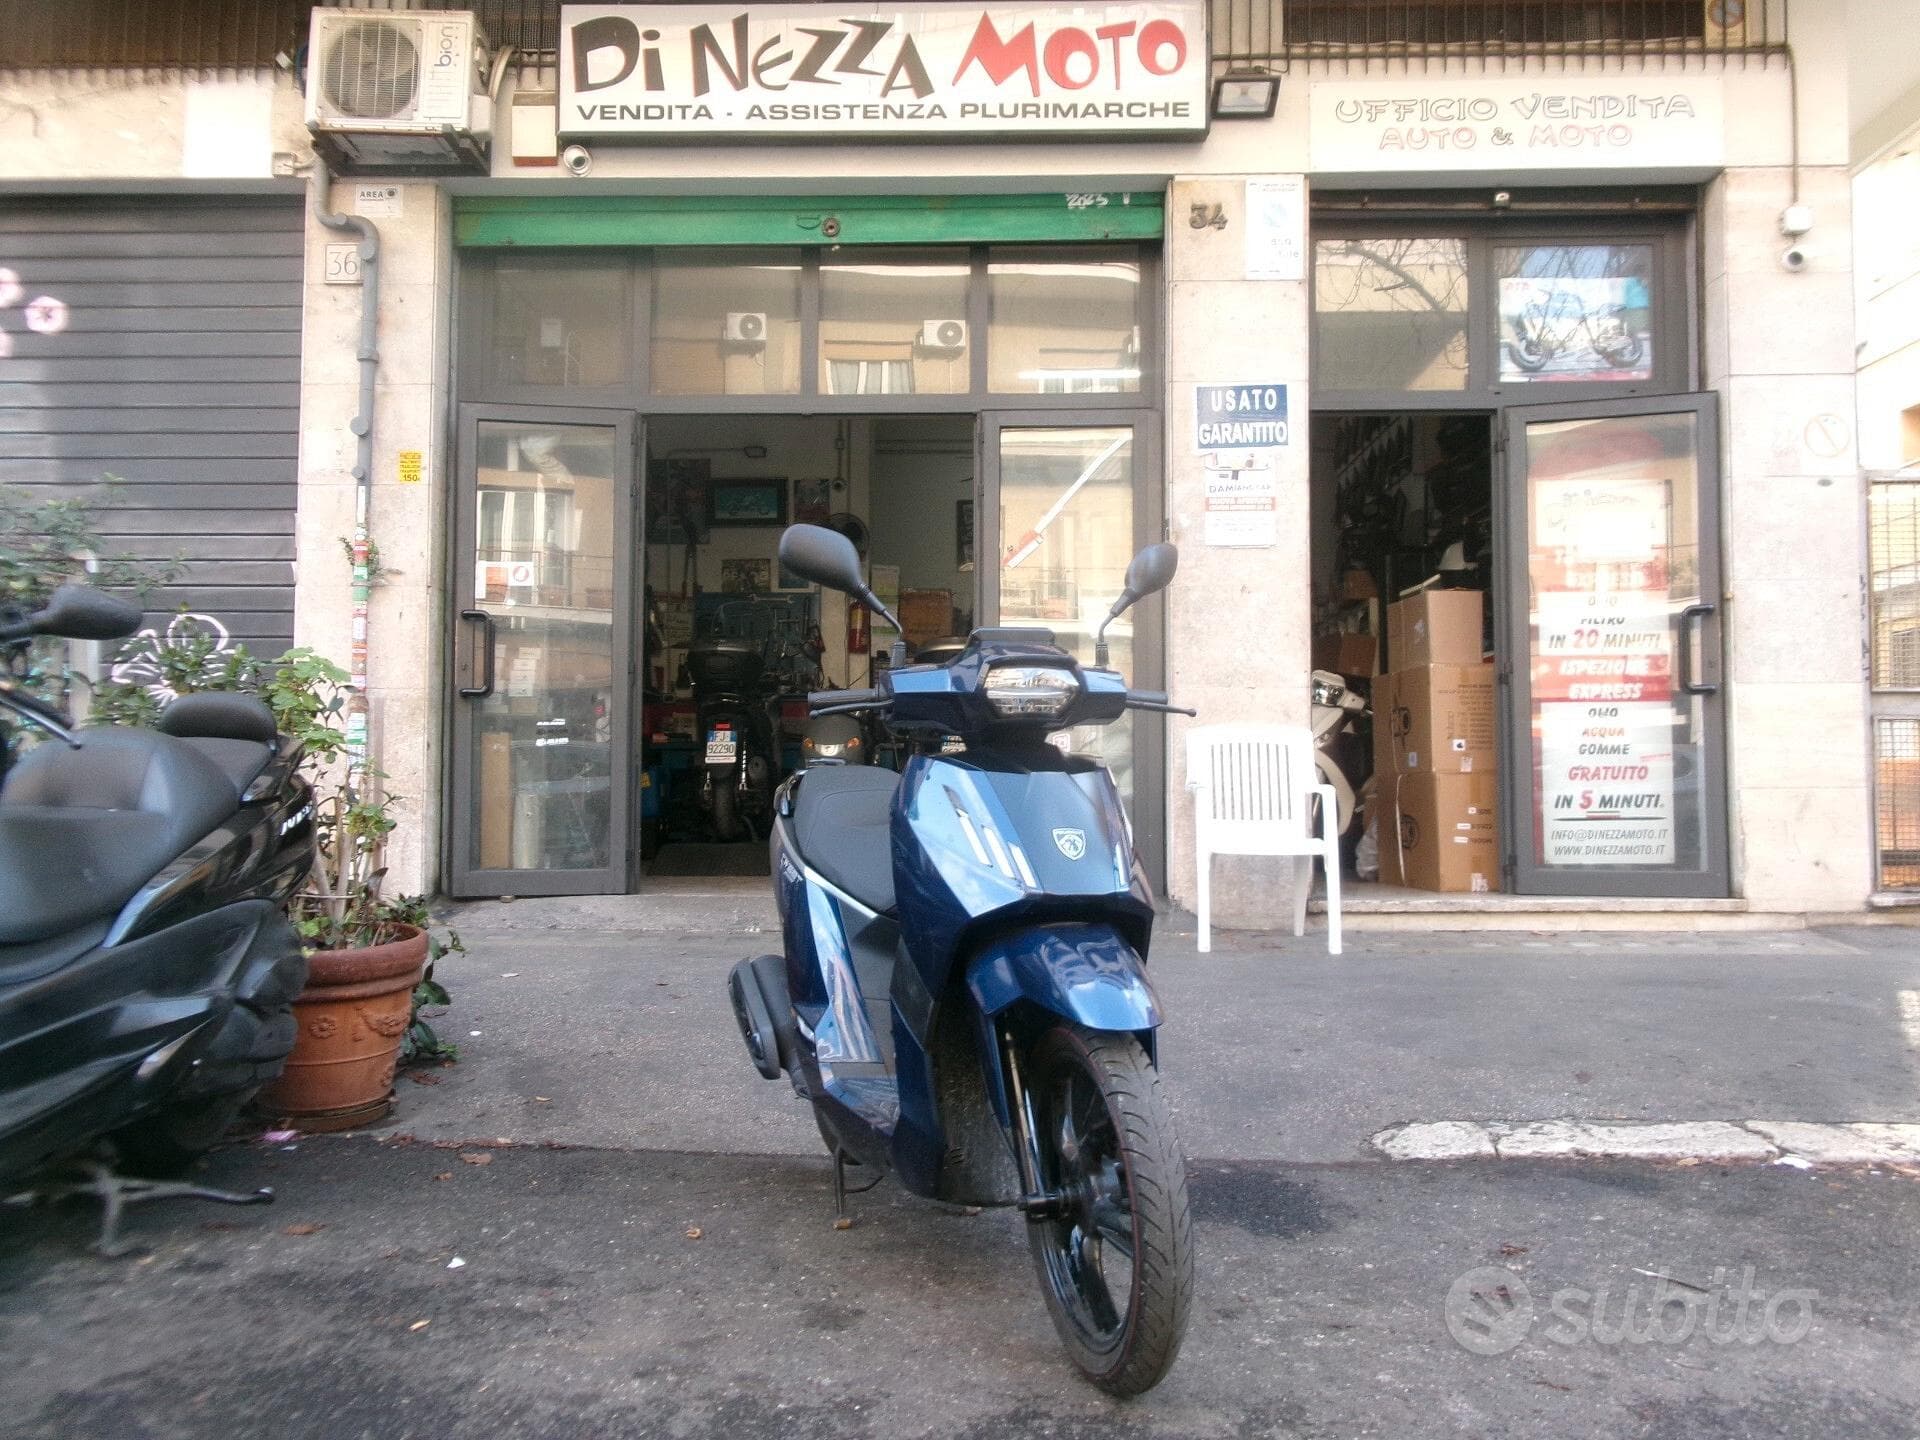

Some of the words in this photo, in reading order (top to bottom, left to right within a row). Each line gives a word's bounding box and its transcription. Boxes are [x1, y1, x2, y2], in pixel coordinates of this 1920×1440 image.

[571, 16, 665, 93] Di
[951, 10, 1187, 97] MOTO
[577, 104, 713, 120] VENDITA
[745, 103, 948, 120] ASSISTENZA
[960, 101, 1190, 119] PLURIMARCHE
[1334, 96, 1499, 123] UFFICIO
[1510, 92, 1696, 120] VENDITA
[1379, 126, 1477, 150] AUTO
[1491, 129, 1514, 145] &
[1529, 123, 1634, 147] MOTO
[327, 250, 358, 276] 36
[1211, 388, 1277, 412] USATO
[1199, 421, 1288, 445] GARANTITO
[1549, 634, 1567, 649] IN
[1574, 628, 1599, 649] 20
[1604, 633, 1662, 649] MINUTI
[1582, 727, 1625, 738] ACQUA
[1579, 743, 1630, 755] GOMME
[1568, 765, 1649, 781] GRATUITO
[1554, 795, 1574, 809] IN
[1579, 790, 1594, 809] 5
[1551, 828, 1668, 842] INFO@DINEZZAMOTO.IT
[1554, 844, 1665, 856] WWW.DINEZZAMOTO.IT
